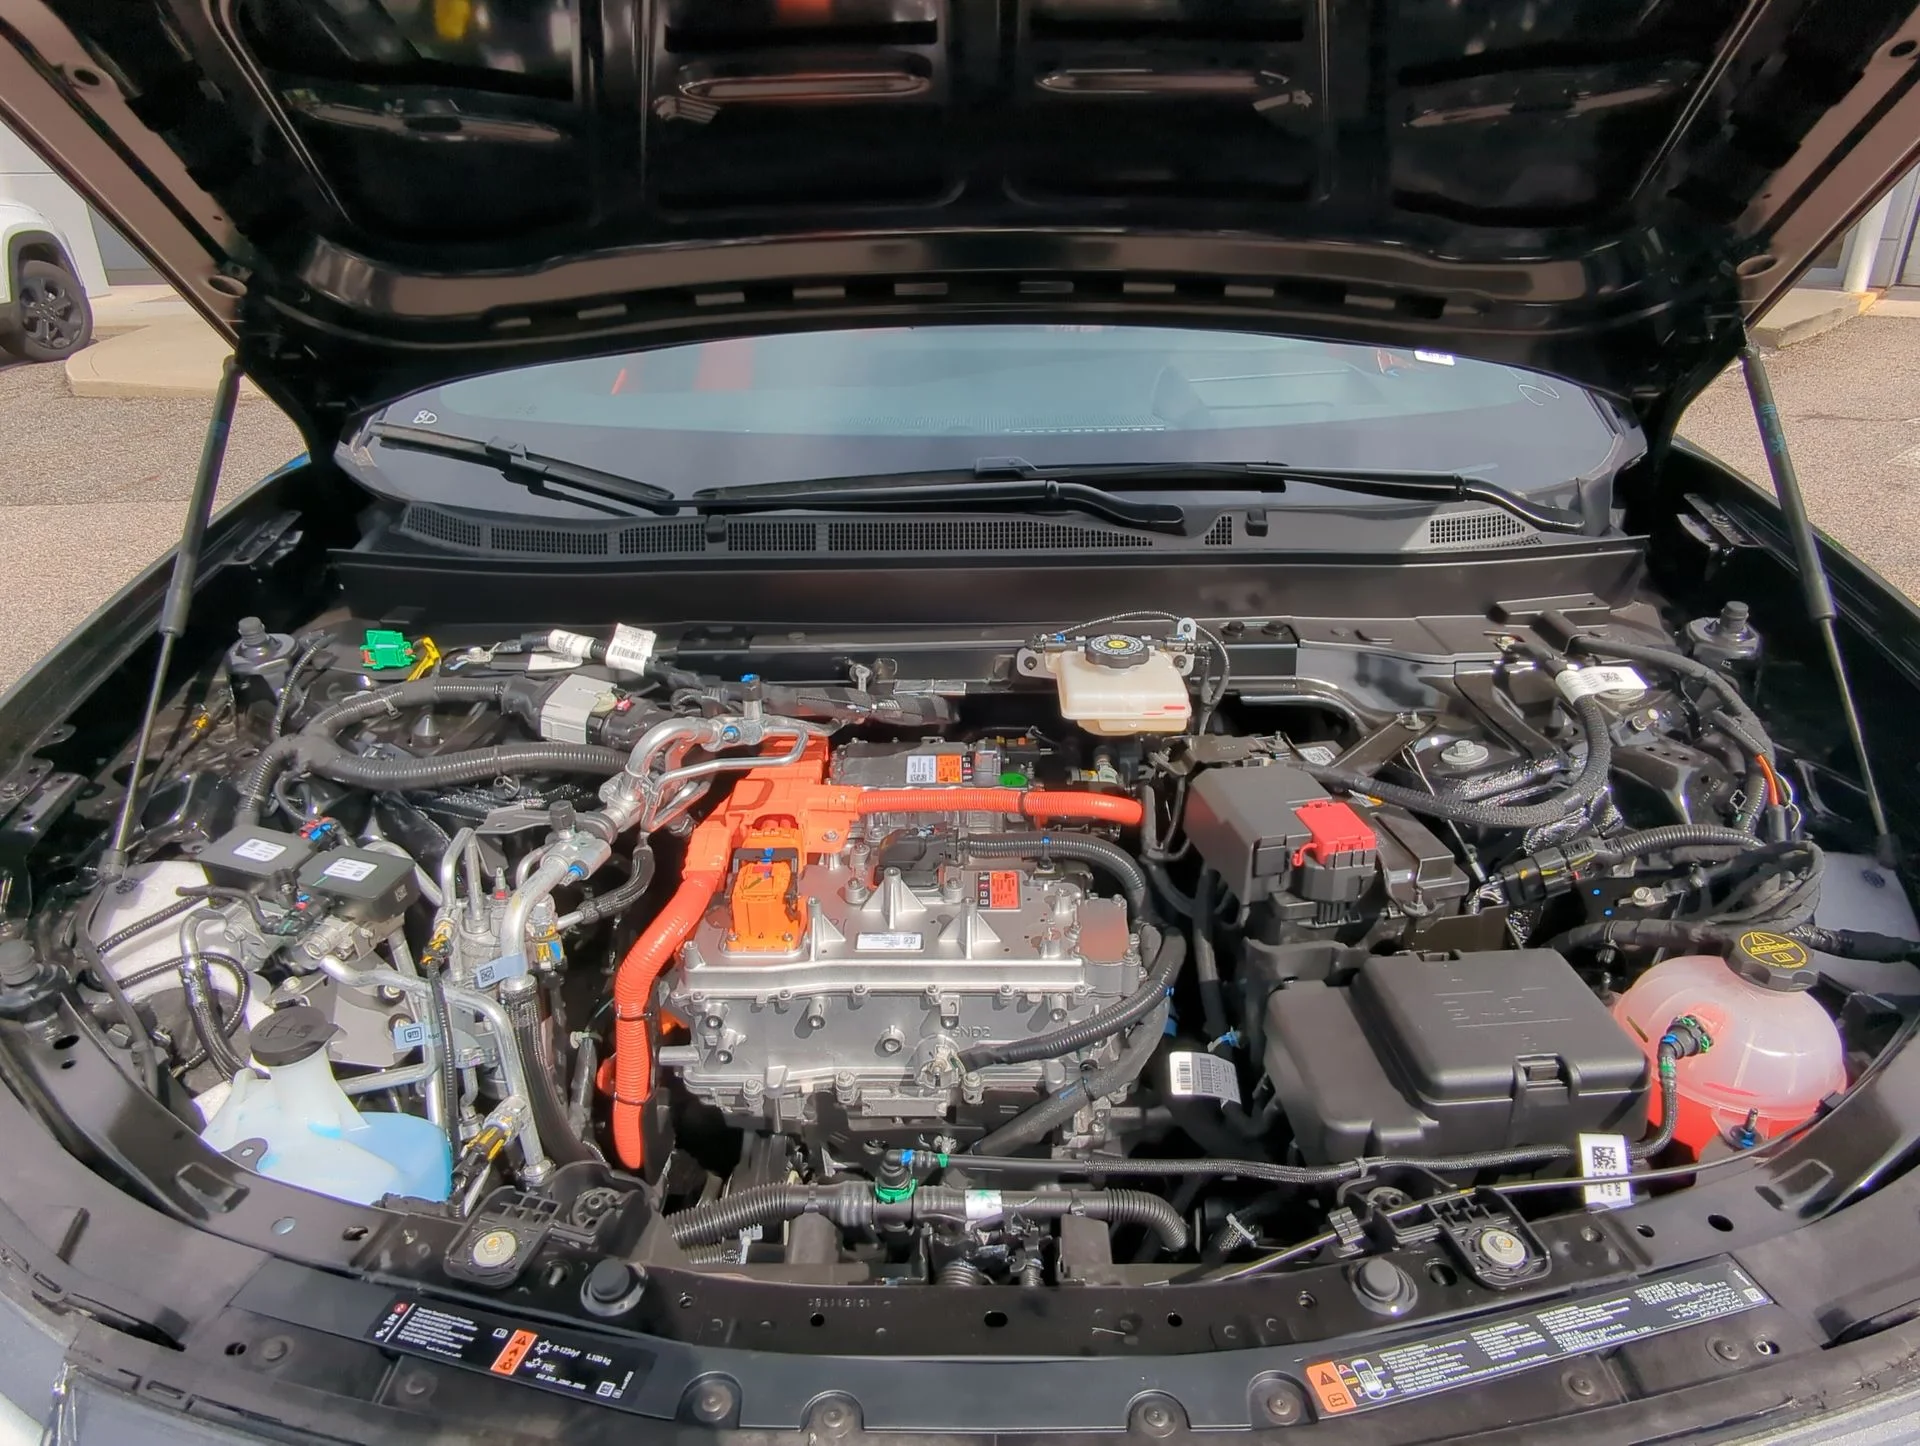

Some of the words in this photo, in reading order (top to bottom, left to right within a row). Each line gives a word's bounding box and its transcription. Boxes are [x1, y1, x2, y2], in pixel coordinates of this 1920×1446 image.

[1750, 943, 1796, 954] ACDelco
[951, 1026, 992, 1037] GND2
[552, 1344, 581, 1358] R-1234yf
